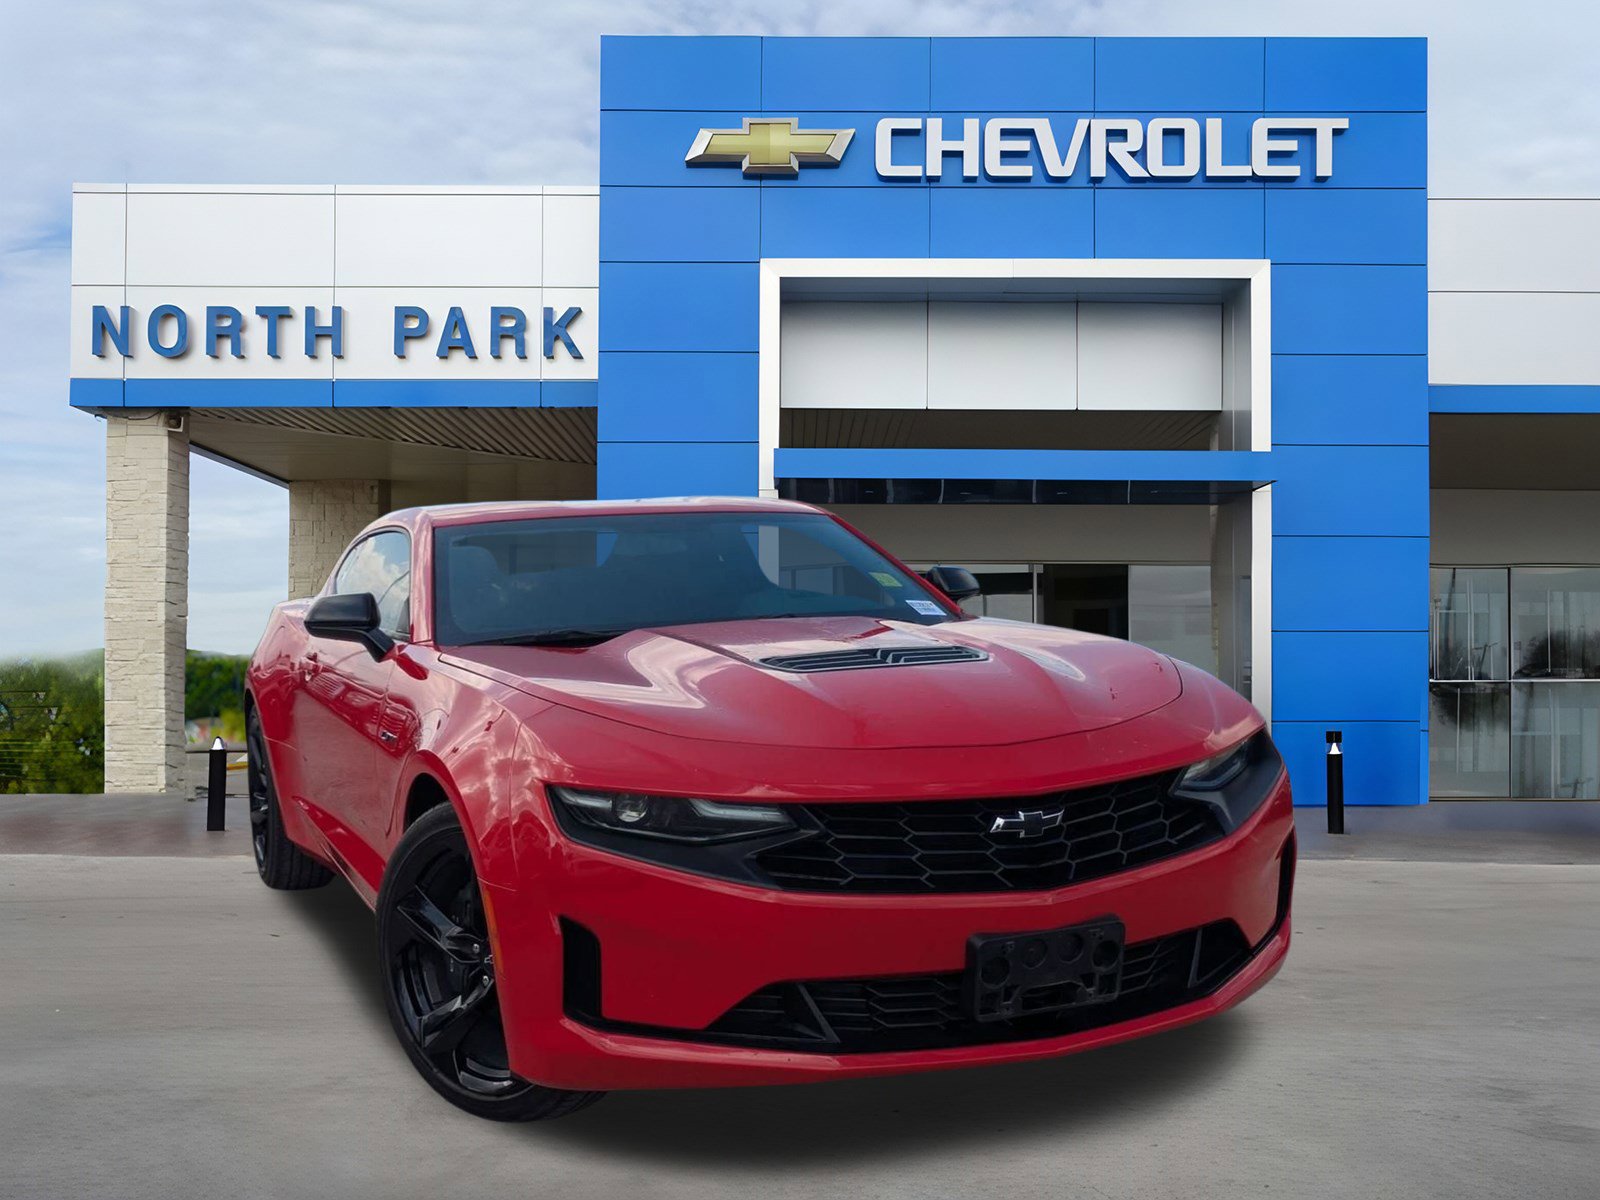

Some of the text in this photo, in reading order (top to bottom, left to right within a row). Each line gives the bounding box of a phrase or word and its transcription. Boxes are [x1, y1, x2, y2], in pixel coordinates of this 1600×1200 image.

[875, 117, 1350, 178] CHEVROLET
[91, 304, 584, 359] NORTH PARK
